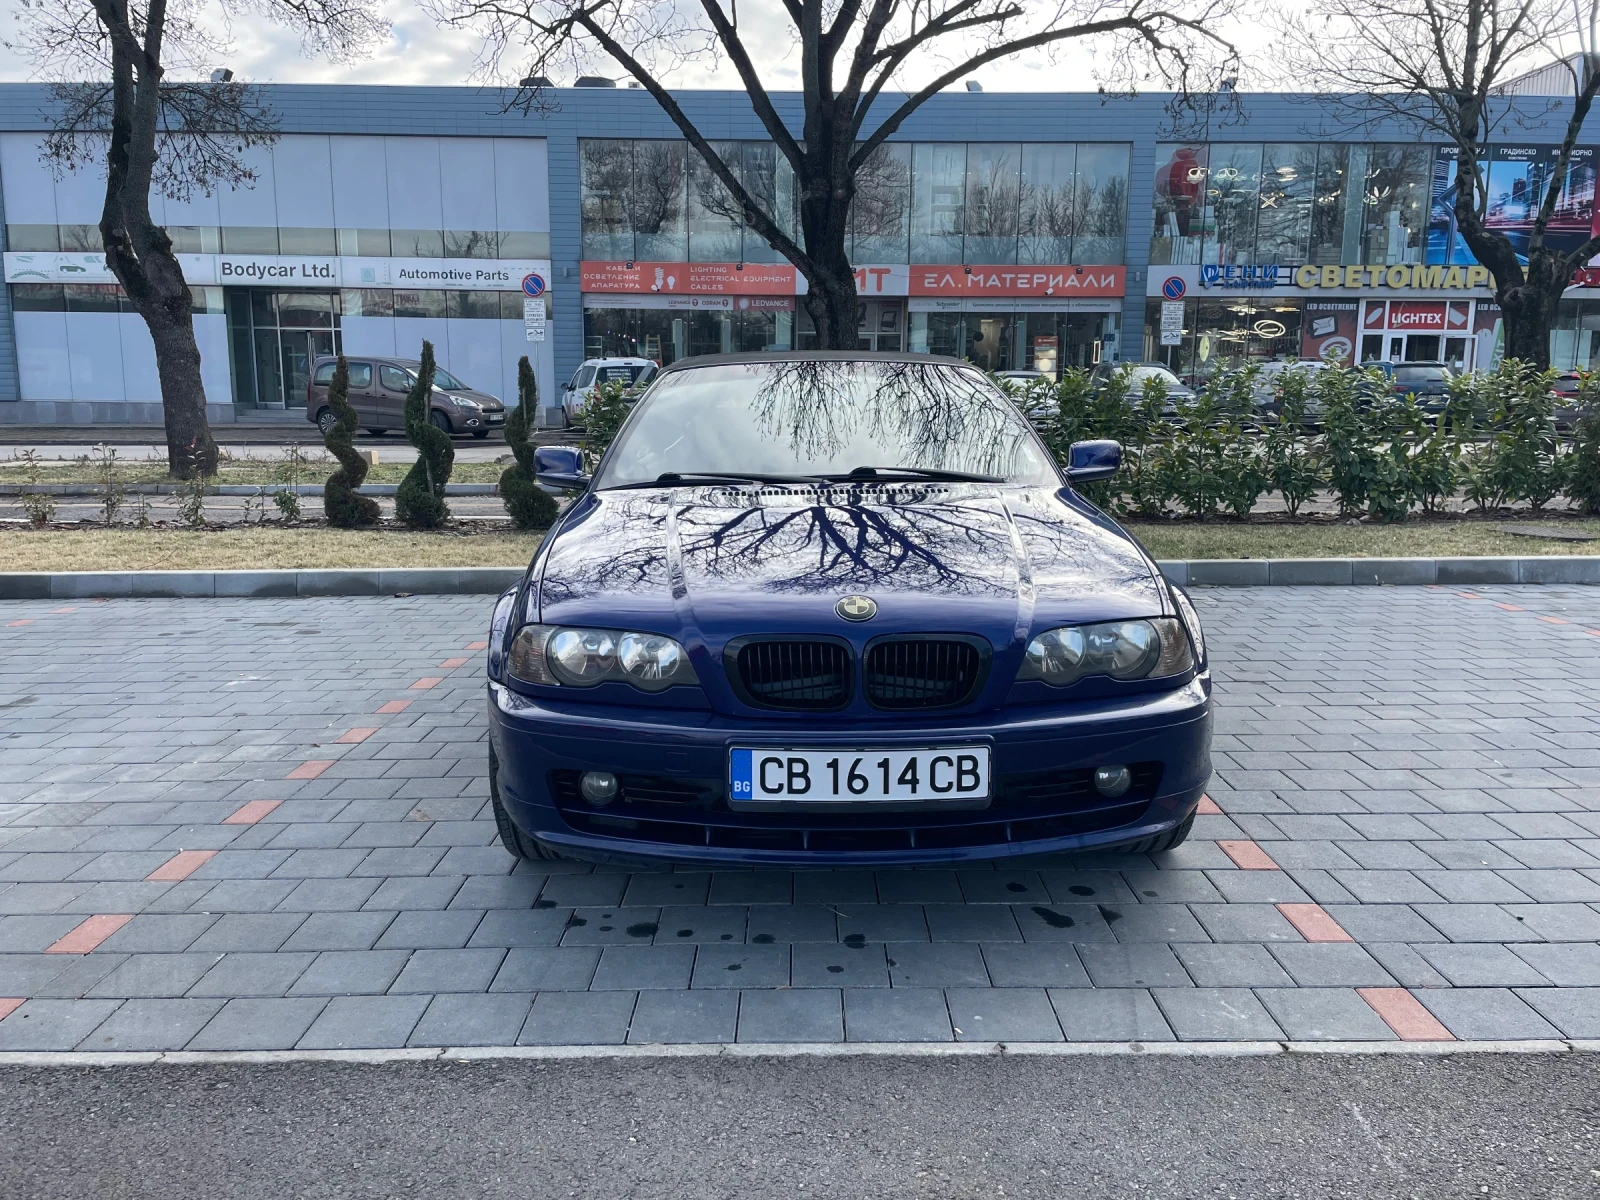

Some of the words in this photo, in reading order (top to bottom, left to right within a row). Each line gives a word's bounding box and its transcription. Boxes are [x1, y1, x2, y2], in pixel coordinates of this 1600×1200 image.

[1500, 148, 1537, 156] ГРАДИНСКО
[221, 262, 297, 280] Bodycar
[302, 263, 335, 278] Ltd.
[399, 269, 472, 280] Automotive
[476, 270, 510, 281] Parts
[967, 273, 1115, 288] МАТЕРИАЛИ
[1306, 303, 1318, 311] LED
[1318, 303, 1357, 311] ОСВЕТЛЕНИЕ
[1391, 313, 1442, 324] LIGHTEX
[759, 756, 812, 795] CB
[826, 757, 920, 795] 1614
[929, 754, 981, 793] CB
[734, 781, 751, 793] BG
